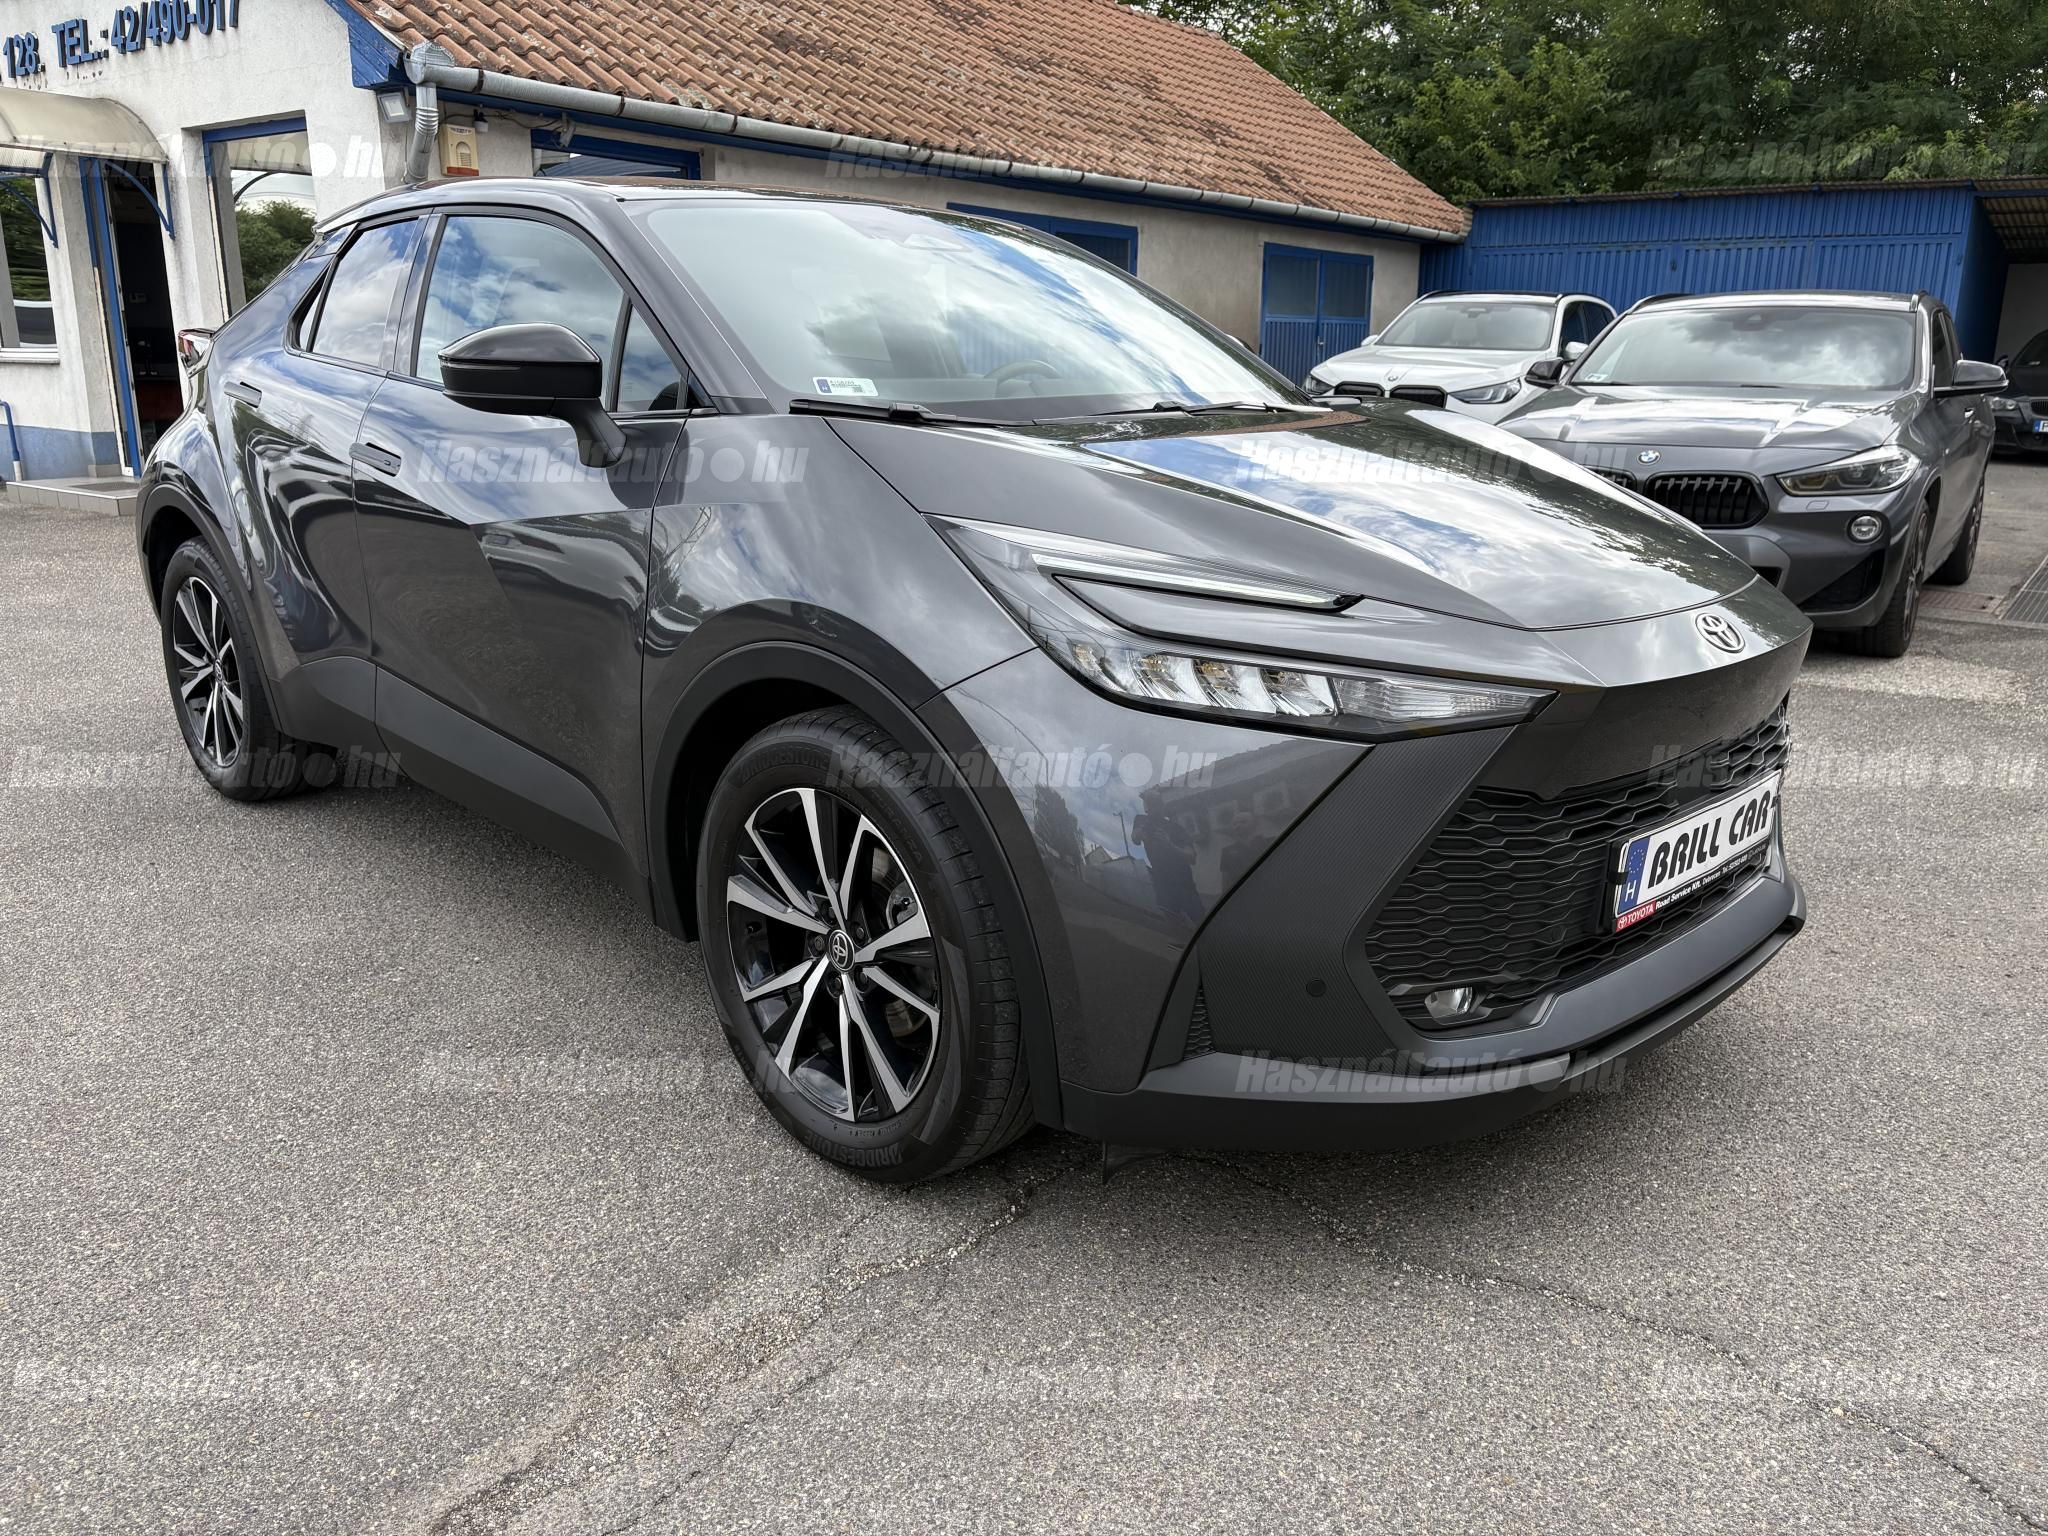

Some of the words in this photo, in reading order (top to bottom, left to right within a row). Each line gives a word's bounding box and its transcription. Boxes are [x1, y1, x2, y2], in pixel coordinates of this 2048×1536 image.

[3, 32, 46, 79] 128.
[1647, 817, 1722, 889] BRILL
[1728, 790, 1771, 846] CAR
[1624, 880, 1636, 903] H
[1655, 897, 1670, 910] Road
[1670, 886, 1691, 902] Service
[1627, 903, 1655, 924] TOYOTA
